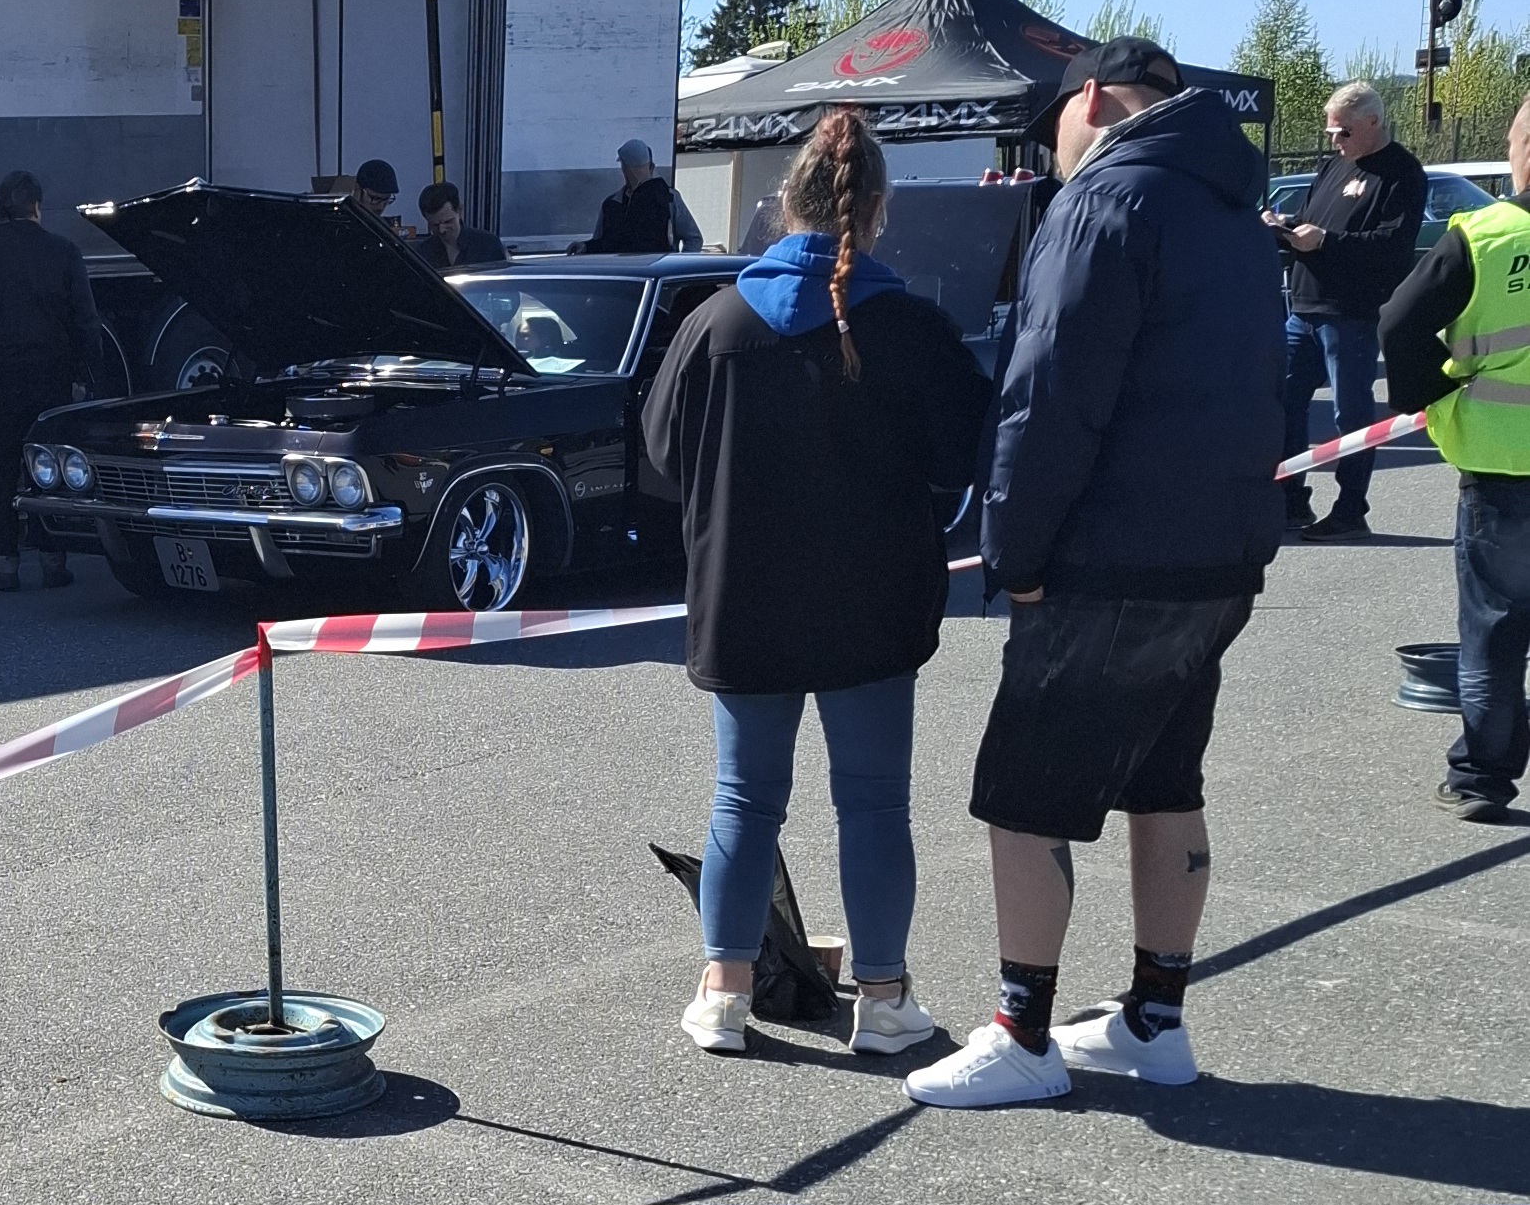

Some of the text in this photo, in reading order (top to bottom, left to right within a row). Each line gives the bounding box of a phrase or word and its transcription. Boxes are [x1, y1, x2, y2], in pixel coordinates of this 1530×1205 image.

[691, 112, 801, 142] 24MX
[876, 101, 999, 129] 24MX
[1506, 254, 1530, 276] D
[1507, 278, 1530, 294] S
[170, 563, 208, 587] 1276
